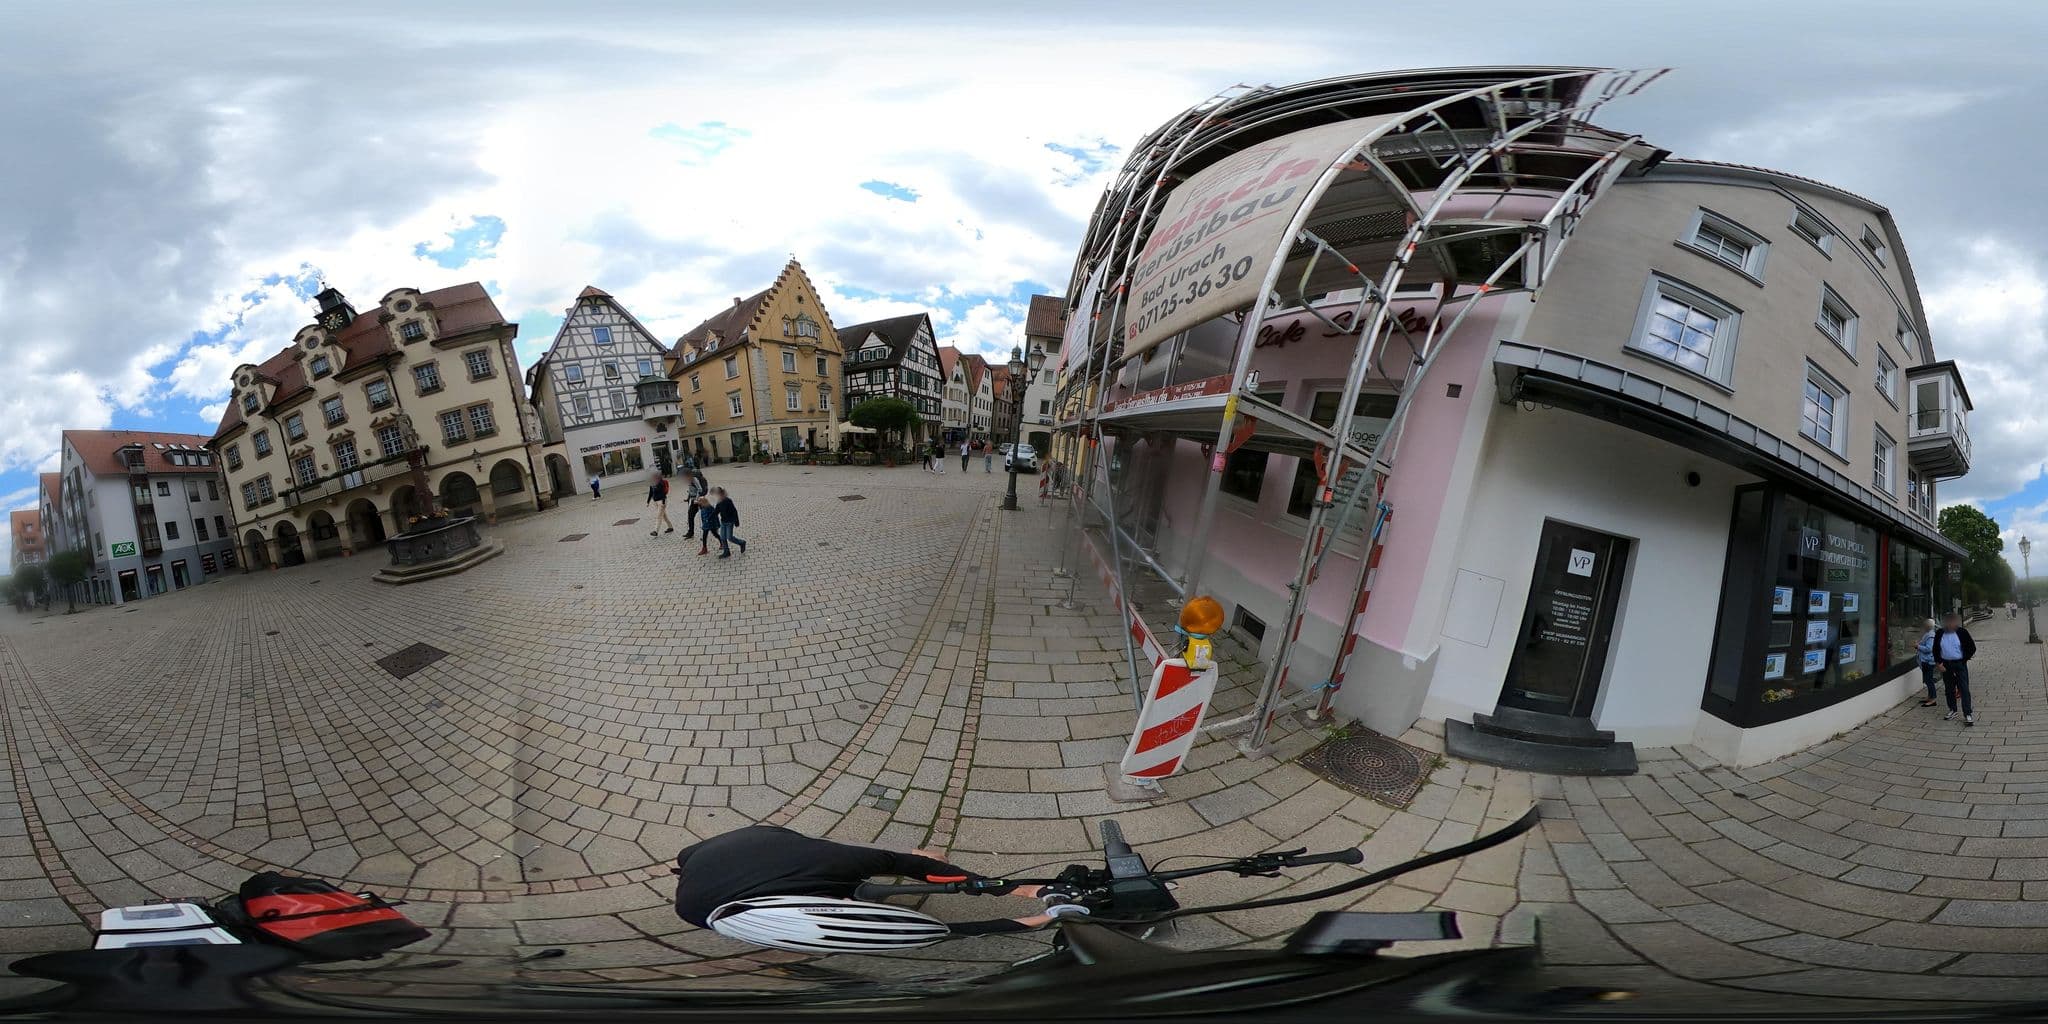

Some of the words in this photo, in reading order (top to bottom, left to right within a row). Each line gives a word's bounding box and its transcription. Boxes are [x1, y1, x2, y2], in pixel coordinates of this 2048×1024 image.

[1134, 185, 1297, 287] Gerüstbau
[1141, 276, 1167, 309] Bad
[1169, 242, 1227, 288] Urach
[115, 543, 135, 553] AOK
[1805, 536, 1819, 551] VP
[1574, 556, 1591, 569] VP
